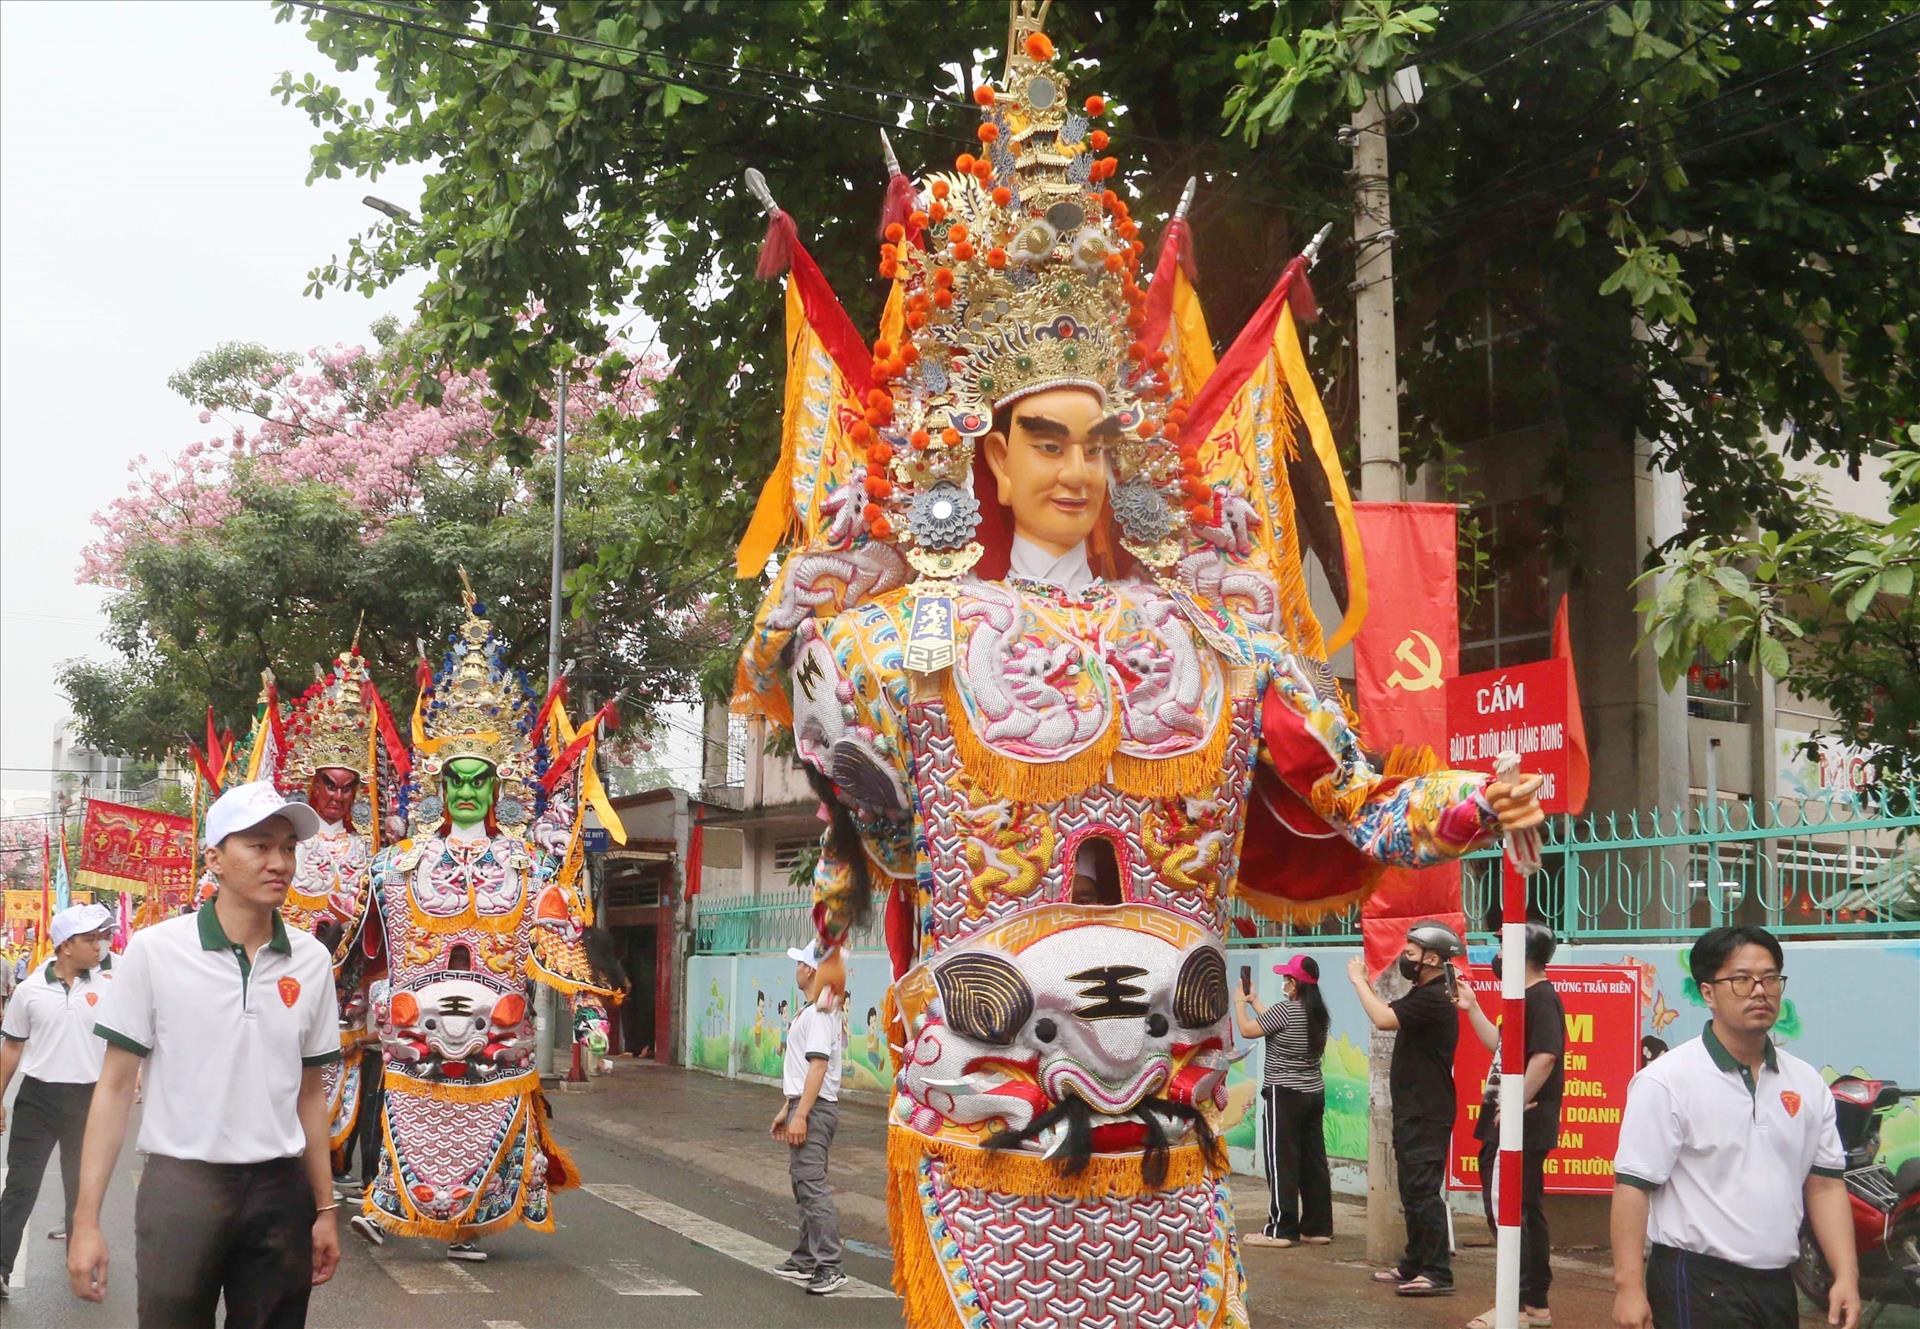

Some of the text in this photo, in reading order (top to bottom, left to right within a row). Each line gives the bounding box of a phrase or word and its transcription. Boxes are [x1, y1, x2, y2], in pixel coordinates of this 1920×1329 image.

[1476, 674, 1525, 715] CẤM
[1450, 732, 1464, 766] ĐẬU
[1466, 735, 1478, 761] XE,
[1479, 728, 1500, 759] BUÔN
[1518, 721, 1539, 755] HÀNG
[1541, 723, 1563, 751] RONG
[1609, 980, 1632, 994] BIÊN
[1567, 1107, 1620, 1124] DOANH
[1563, 1154, 1615, 1176] TRƯỜN
